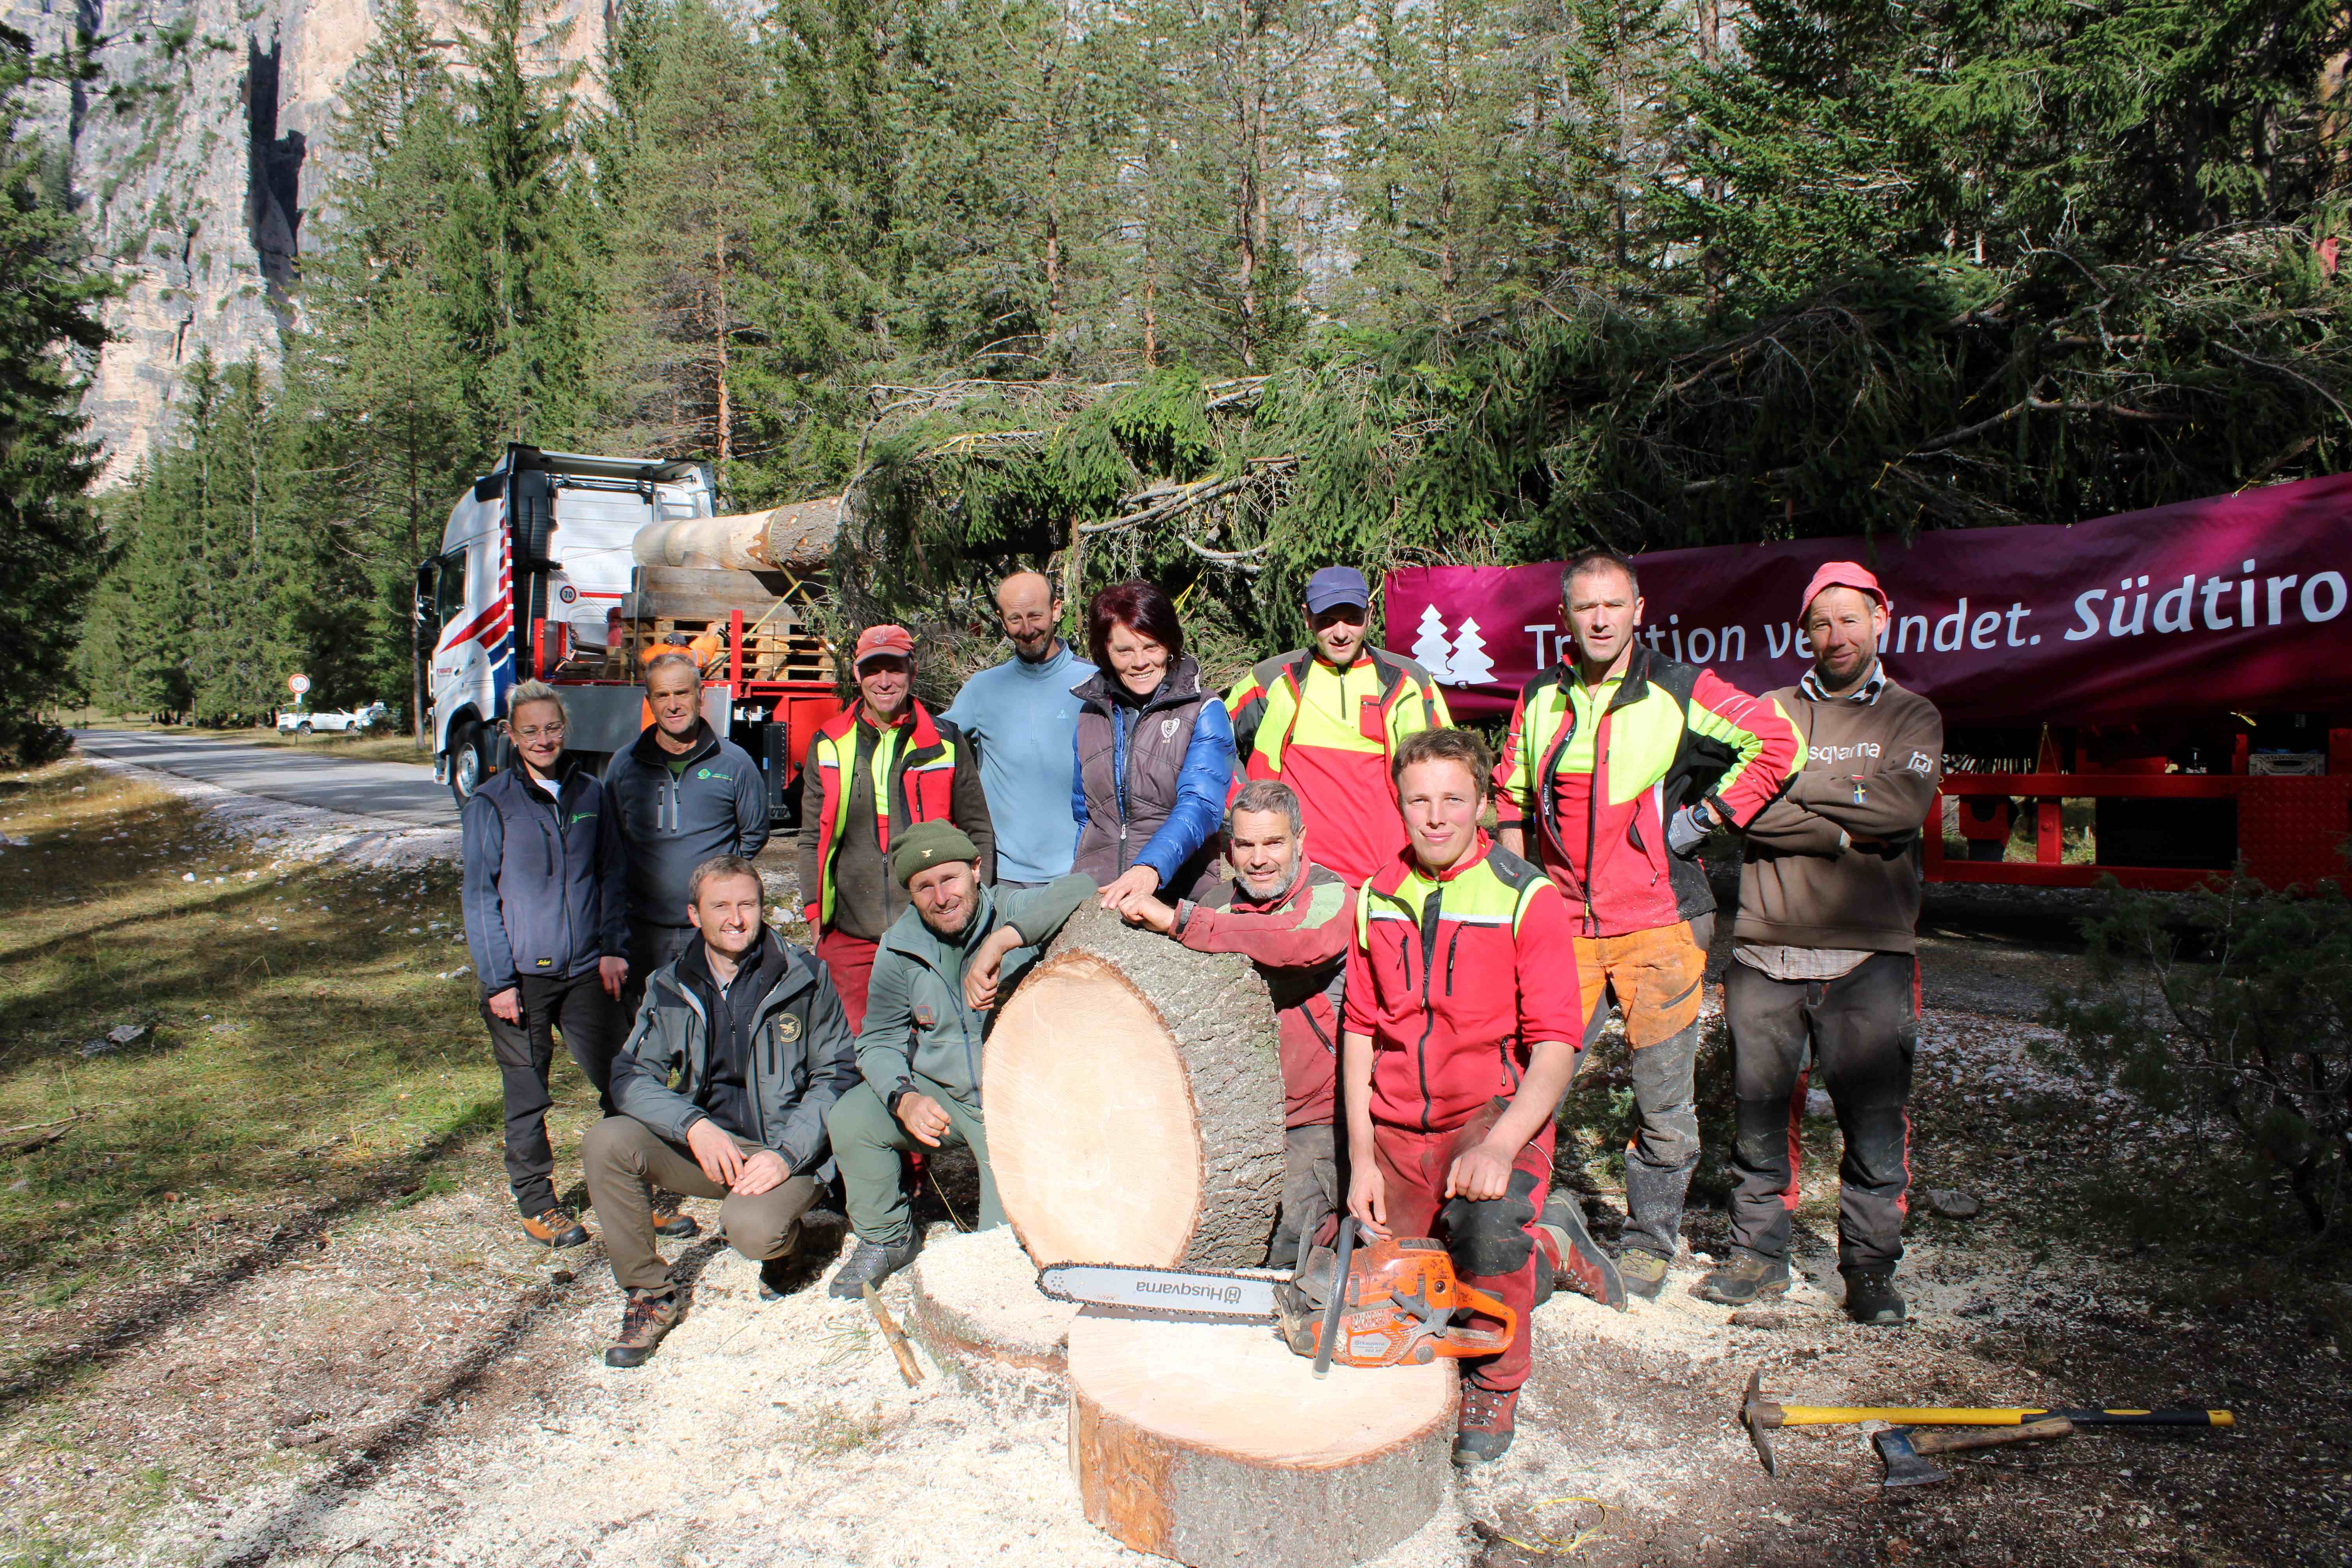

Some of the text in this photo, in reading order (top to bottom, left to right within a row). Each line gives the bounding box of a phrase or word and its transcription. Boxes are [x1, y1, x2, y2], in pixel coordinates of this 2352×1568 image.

[1524, 558, 2348, 670] Trtion veindet. Südtiro
[294, 679, 305, 688] 50
[1808, 742, 1881, 765] sqvarna
[1136, 1281, 1223, 1301] Husqvarna
